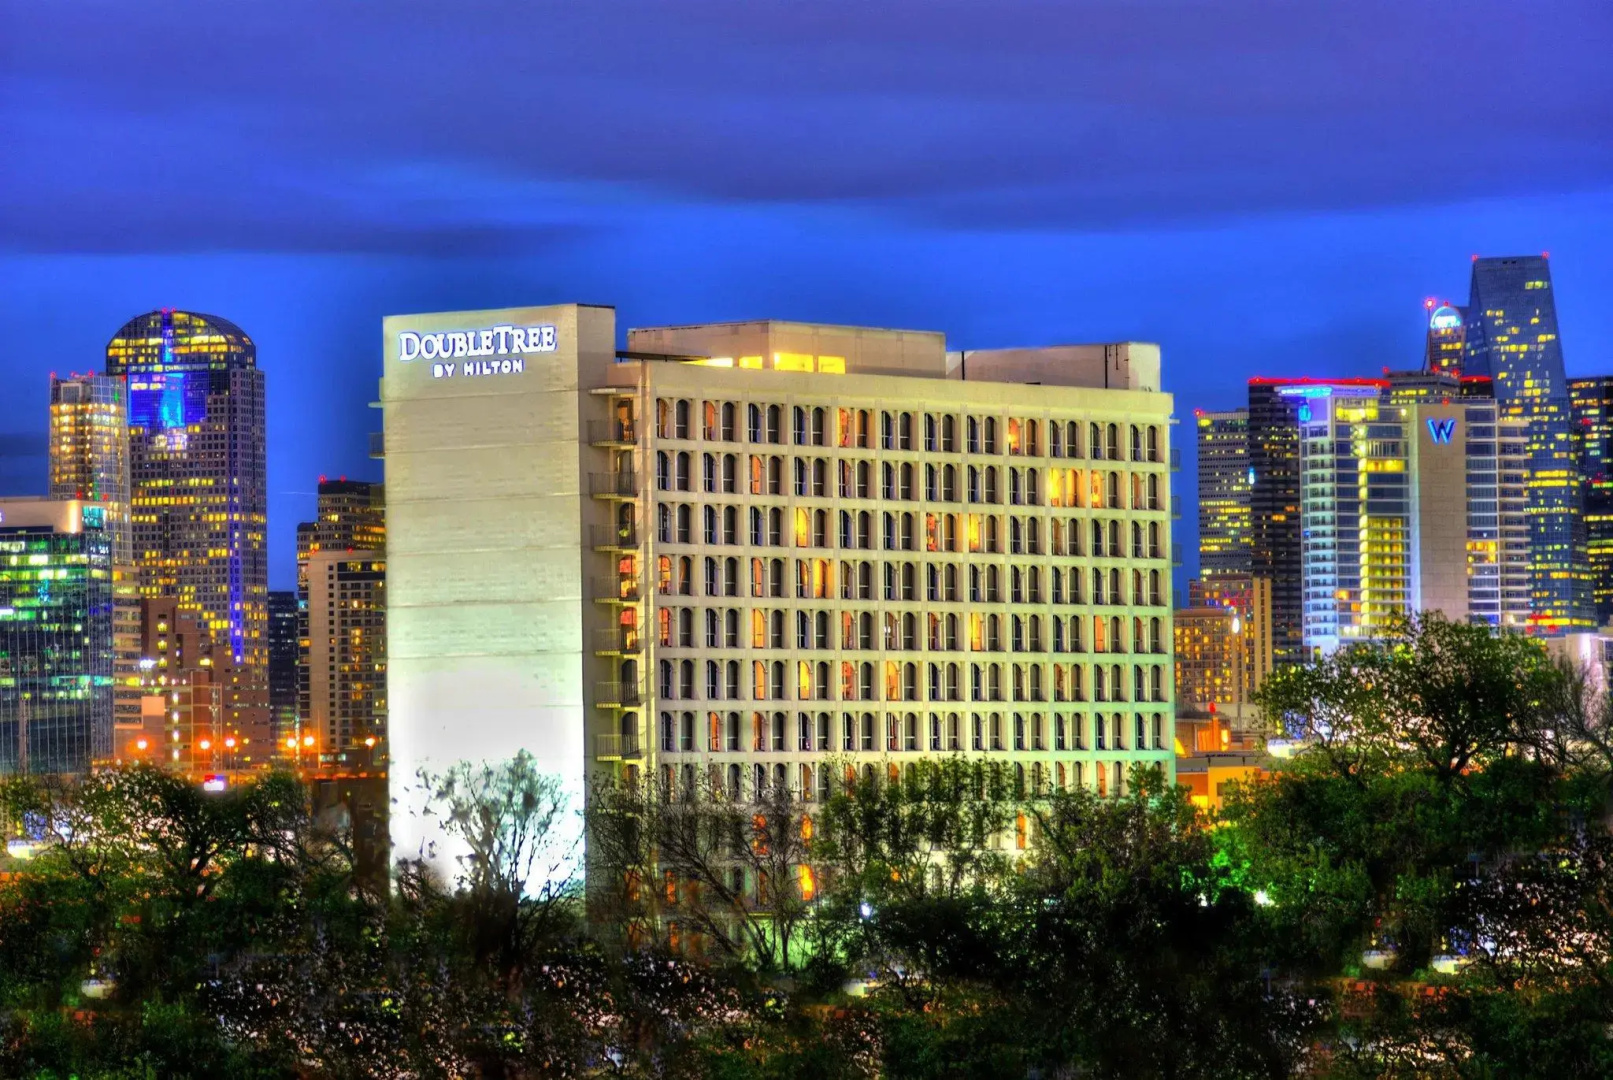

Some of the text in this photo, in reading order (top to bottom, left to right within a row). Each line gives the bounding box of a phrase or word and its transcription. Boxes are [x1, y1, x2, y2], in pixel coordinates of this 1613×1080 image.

[433, 359, 524, 378] BY HILTON
[1427, 418, 1455, 444] W
